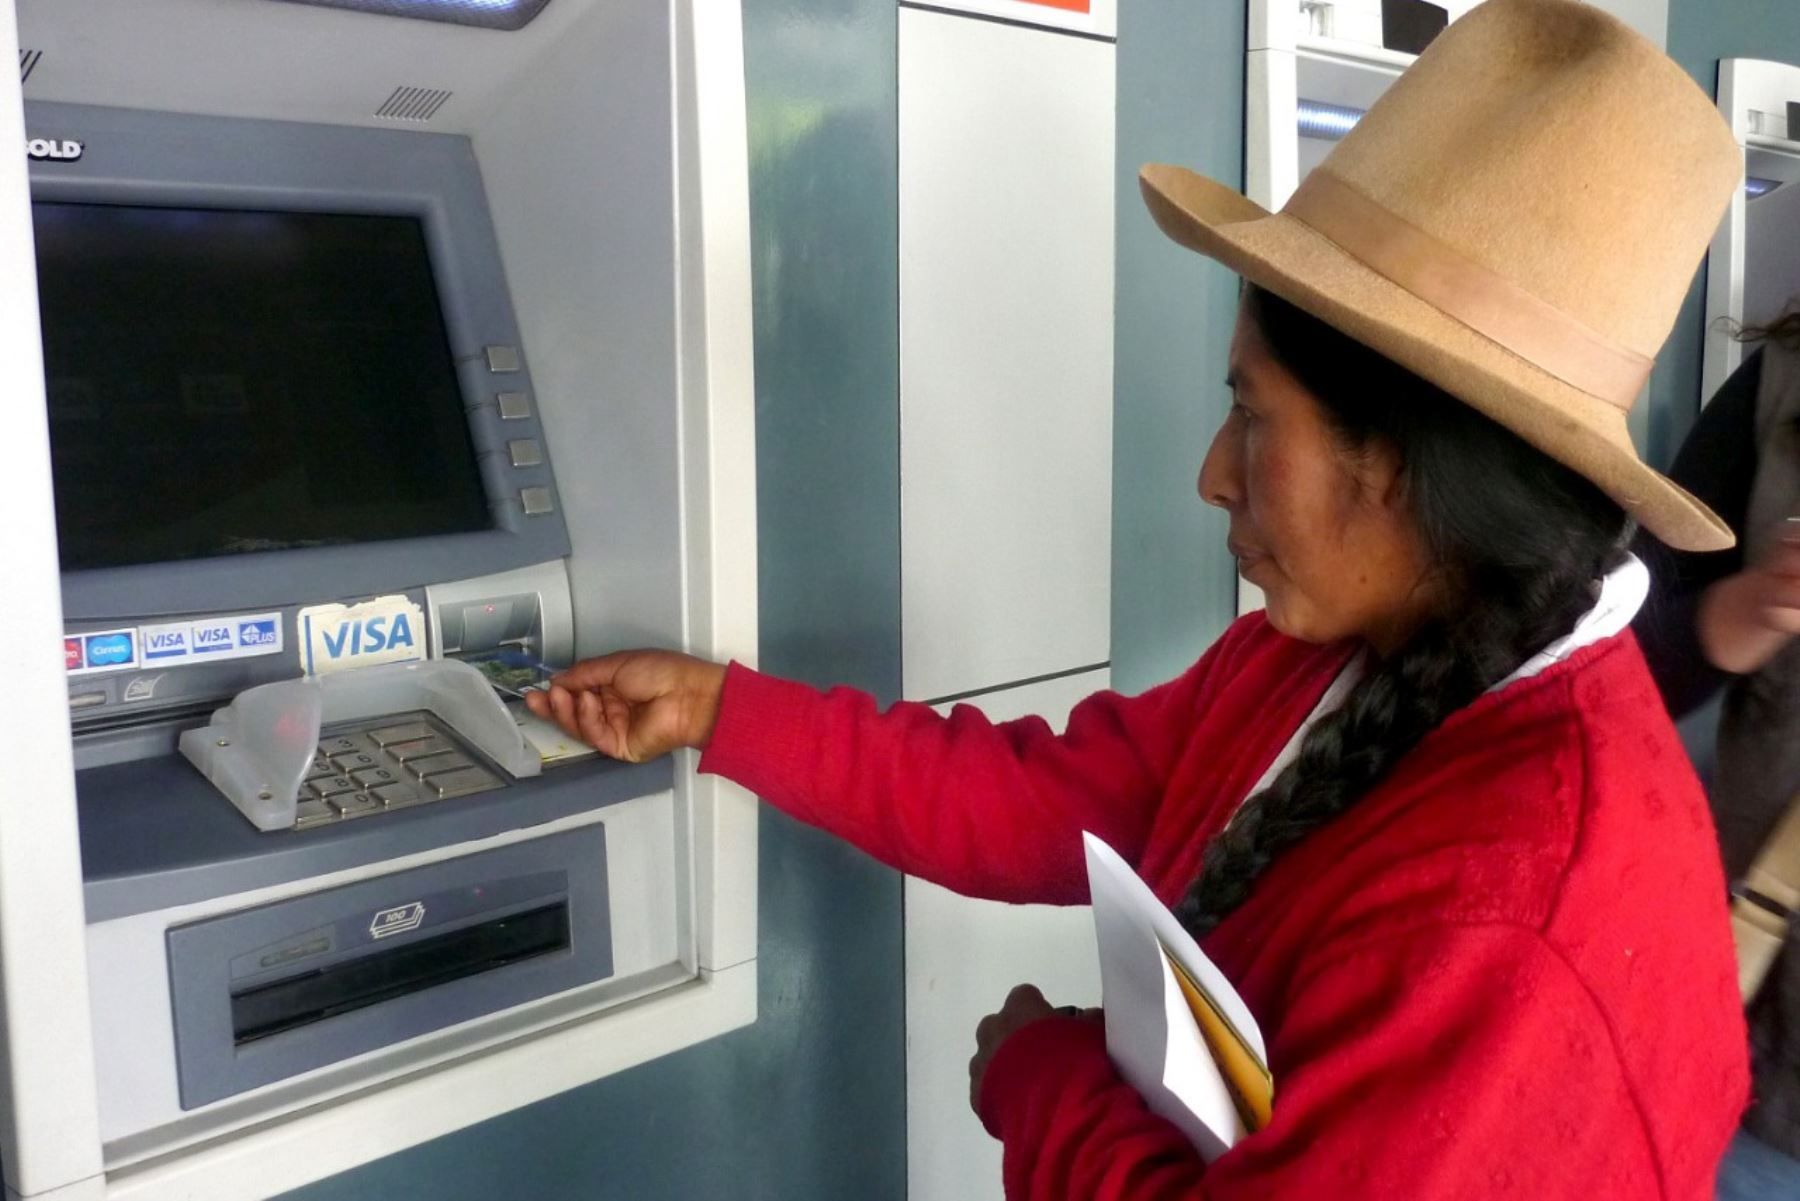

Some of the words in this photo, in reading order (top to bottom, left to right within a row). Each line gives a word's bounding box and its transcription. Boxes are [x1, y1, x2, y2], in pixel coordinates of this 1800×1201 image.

[150, 633, 184, 648] VISA
[197, 628, 230, 643] VISA
[249, 632, 275, 645] PLUS
[322, 613, 414, 659] VISA
[386, 911, 406, 922] 100
